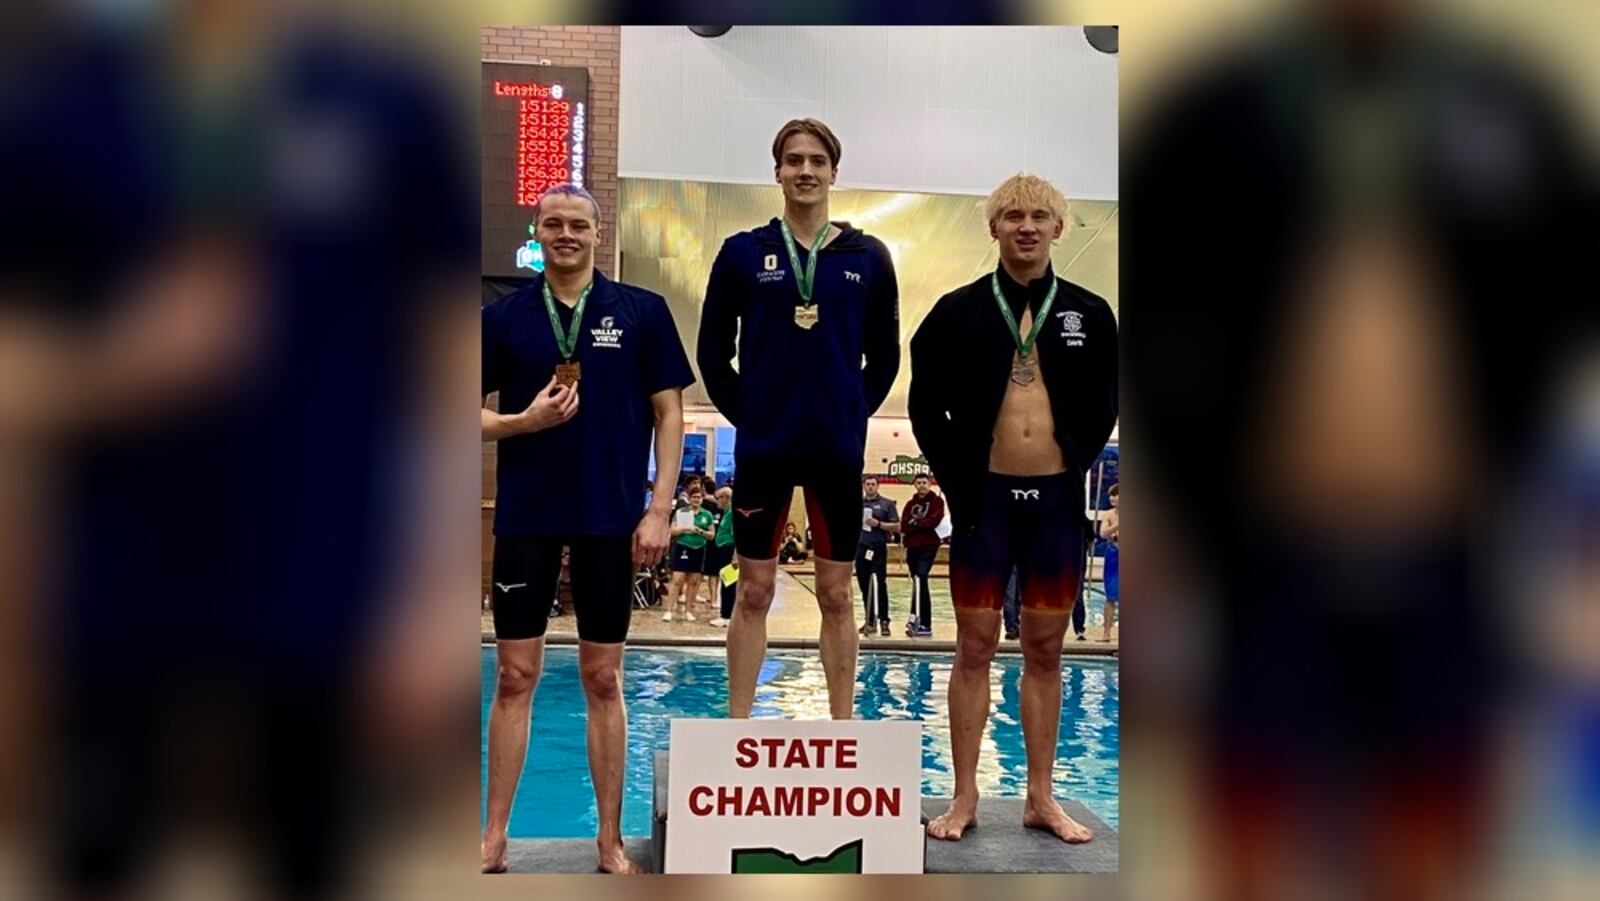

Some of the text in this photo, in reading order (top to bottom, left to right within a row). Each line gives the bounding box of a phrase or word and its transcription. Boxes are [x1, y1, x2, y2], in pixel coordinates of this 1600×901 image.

[577, 102, 584, 116] 1
[573, 115, 584, 129] 2
[572, 128, 584, 142] 3
[572, 141, 583, 154] 4
[572, 154, 583, 168] 5
[571, 168, 583, 182] 6
[590, 328, 624, 337] VALLEY
[1011, 489, 1040, 500] TYR
[735, 738, 858, 769] STATE
[688, 785, 901, 817] CHAMPION
